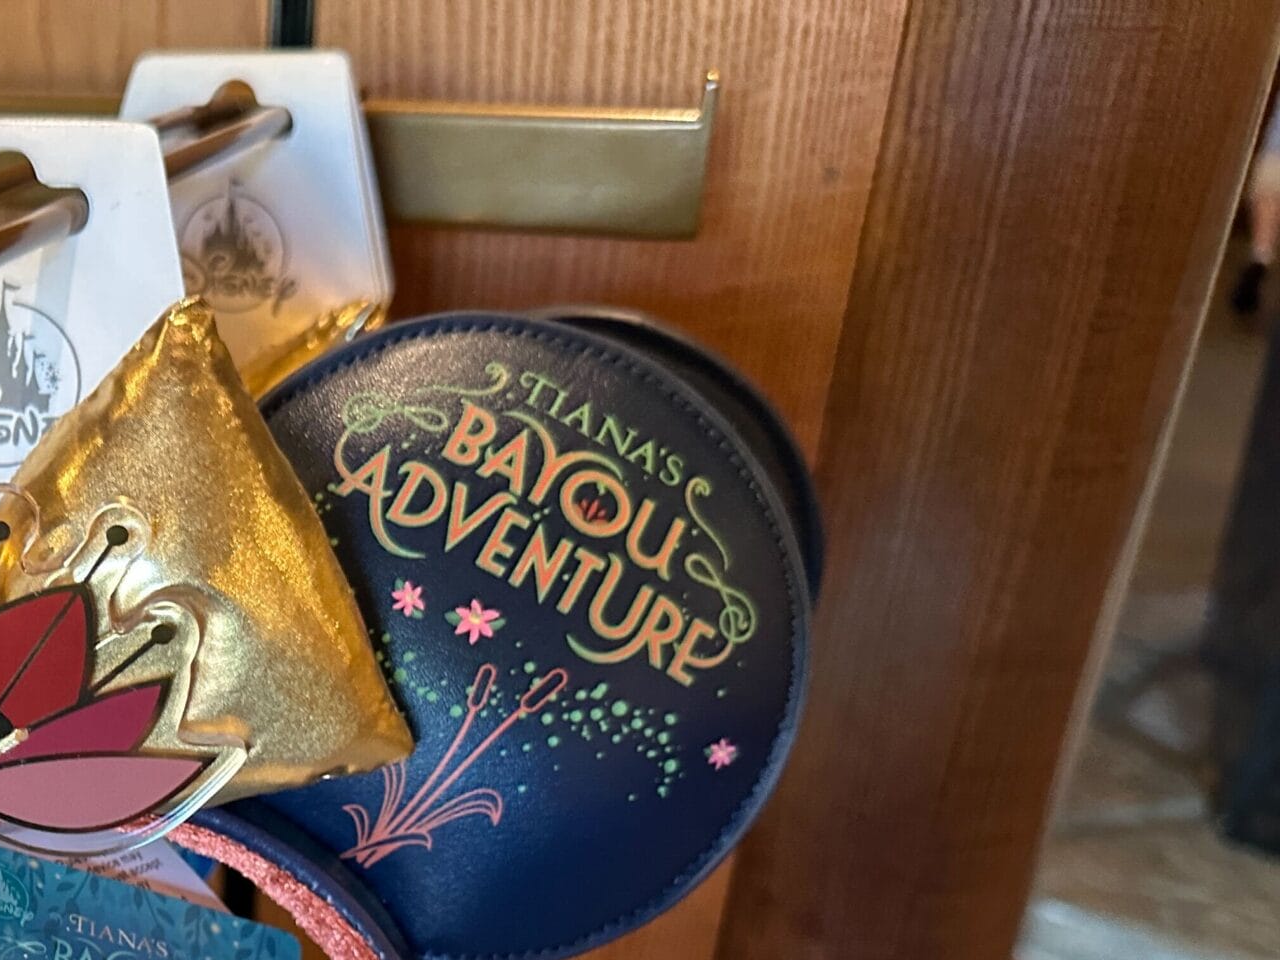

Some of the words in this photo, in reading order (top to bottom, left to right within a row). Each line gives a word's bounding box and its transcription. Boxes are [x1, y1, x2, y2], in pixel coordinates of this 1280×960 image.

[442, 398, 686, 582] BAYOU
[520, 371, 684, 488] TIANA'S
[334, 432, 733, 687] ADVENTURE
[67, 912, 169, 959] TIANA'S
